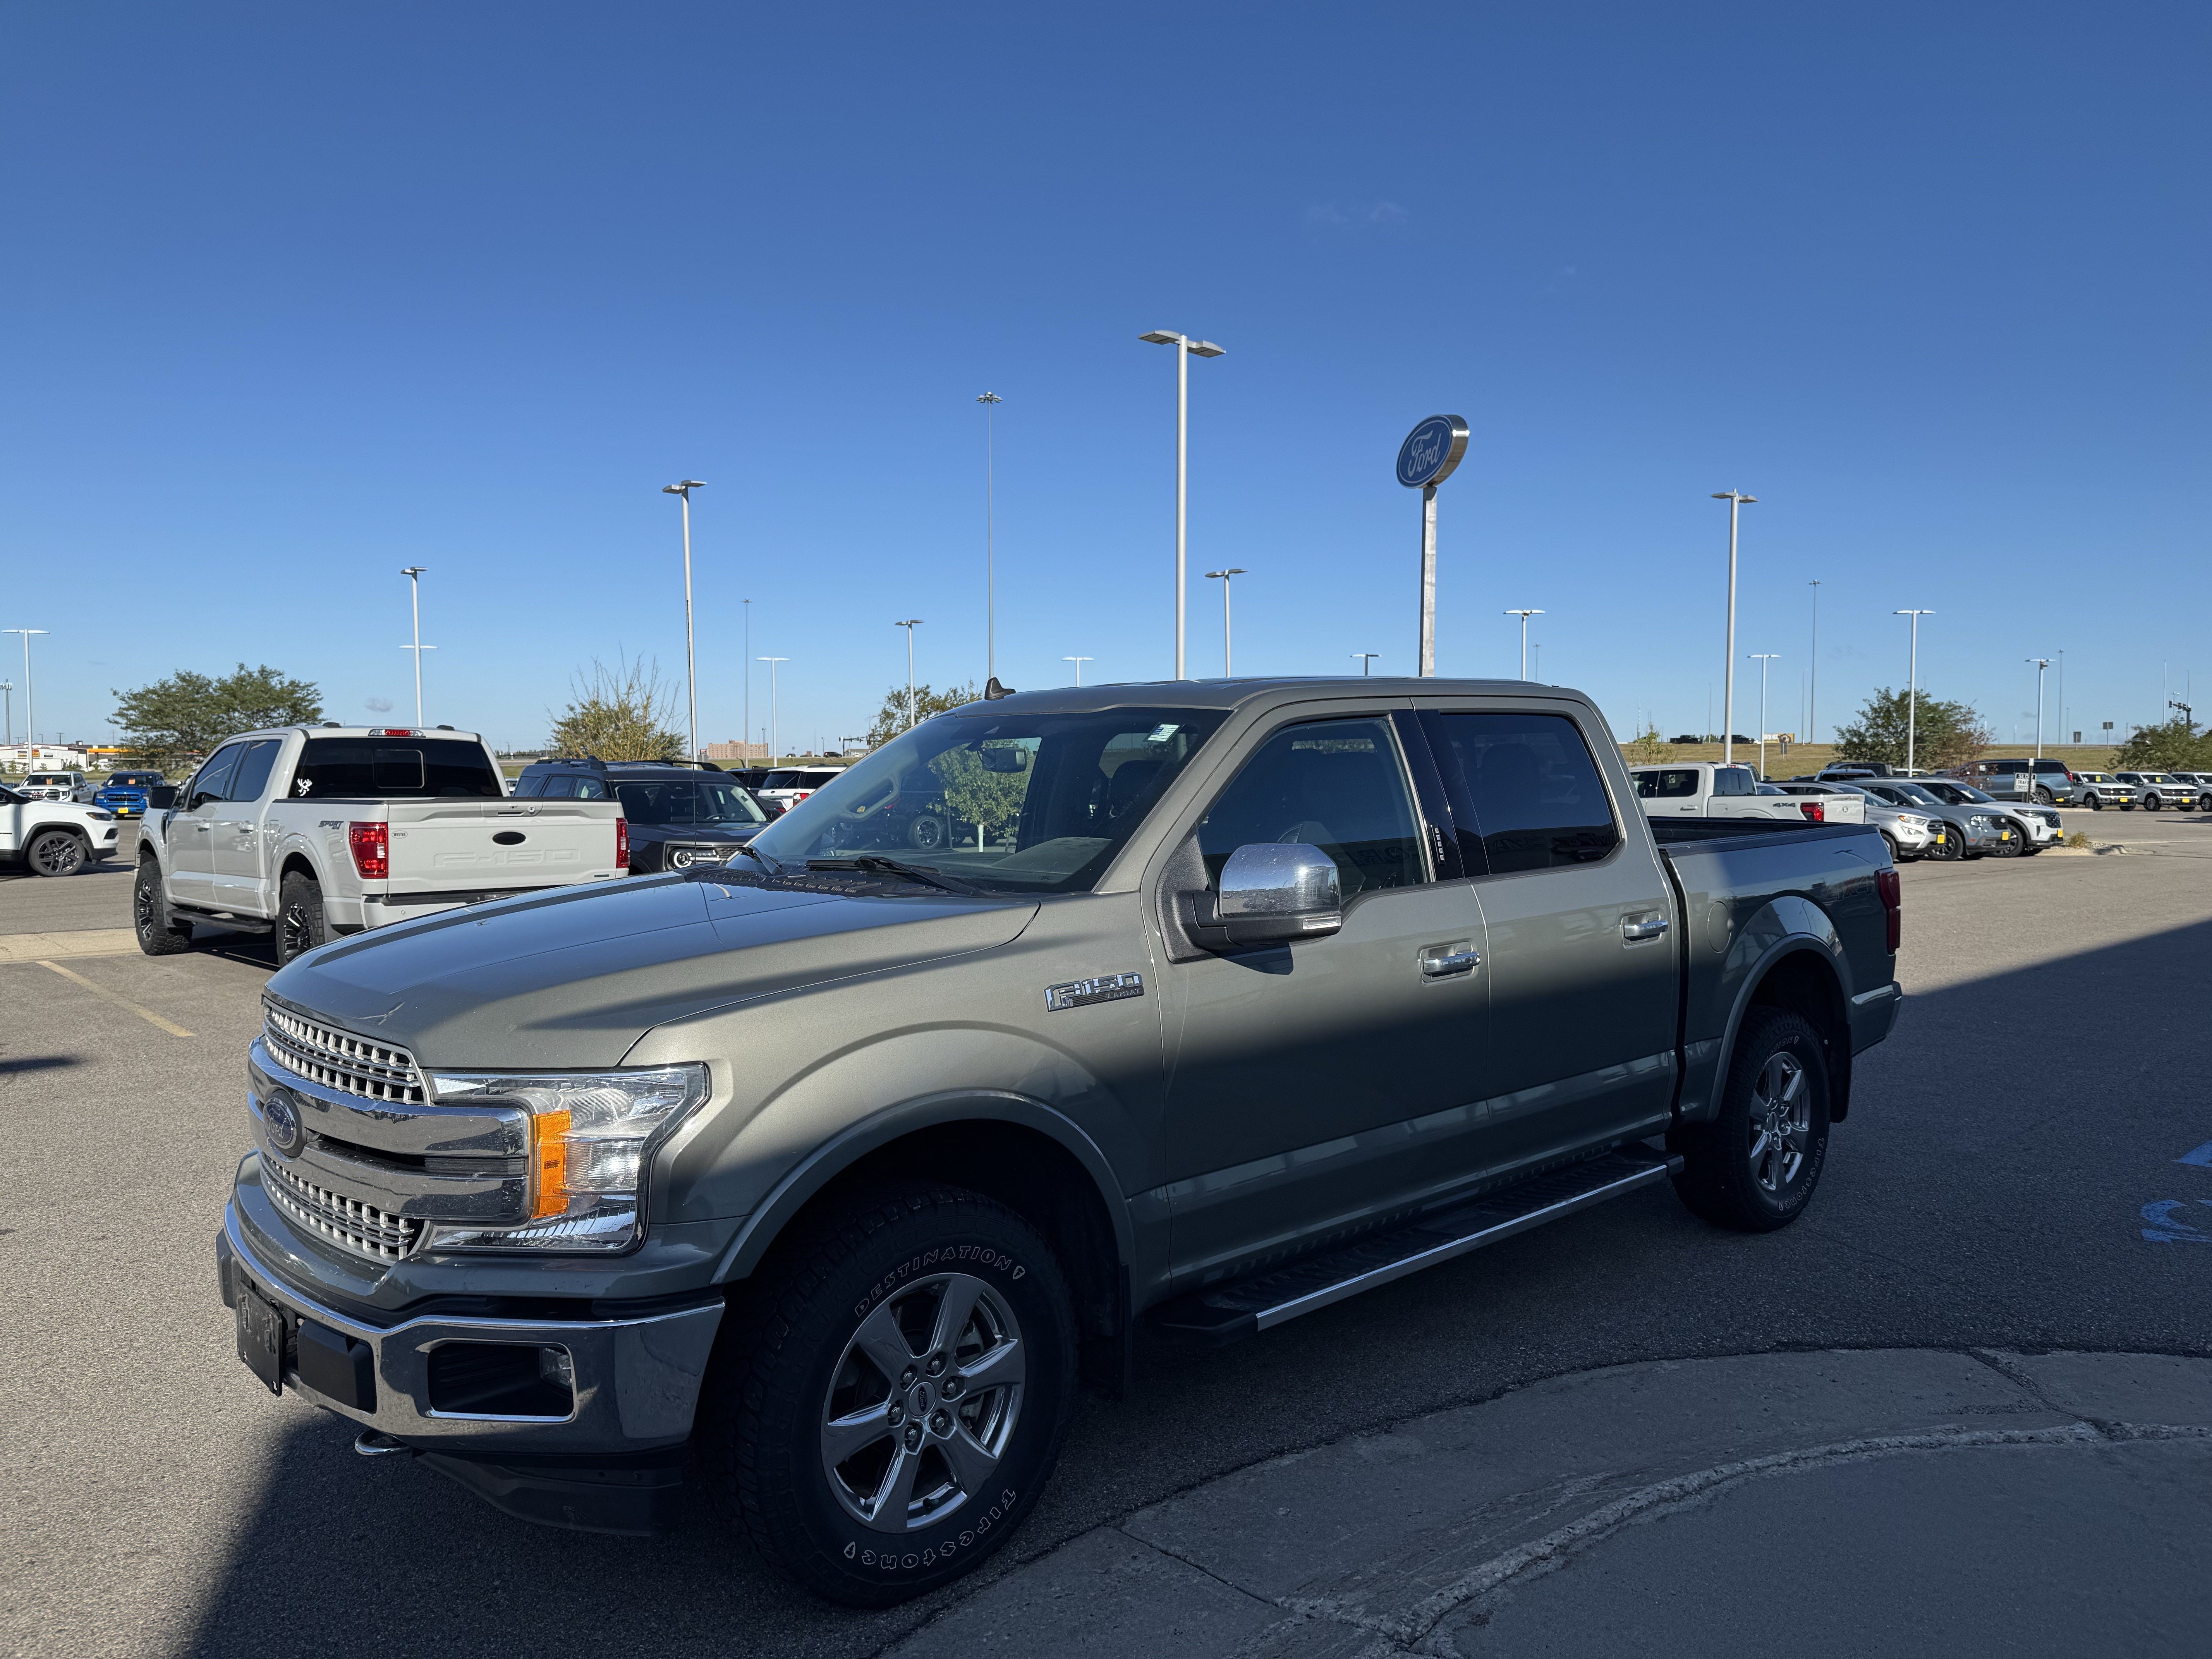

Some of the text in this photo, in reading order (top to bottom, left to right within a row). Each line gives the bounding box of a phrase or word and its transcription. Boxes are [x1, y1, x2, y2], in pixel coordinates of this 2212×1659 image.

[1408, 430, 1441, 477] Ford
[318, 821, 344, 830] SPORT
[434, 849, 580, 867] F-150
[1107, 988, 1140, 999] LARIAT
[266, 1107, 287, 1139] Ford
[854, 1246, 1012, 1317] DESTINATION
[862, 1489, 1016, 1570] Firestone
